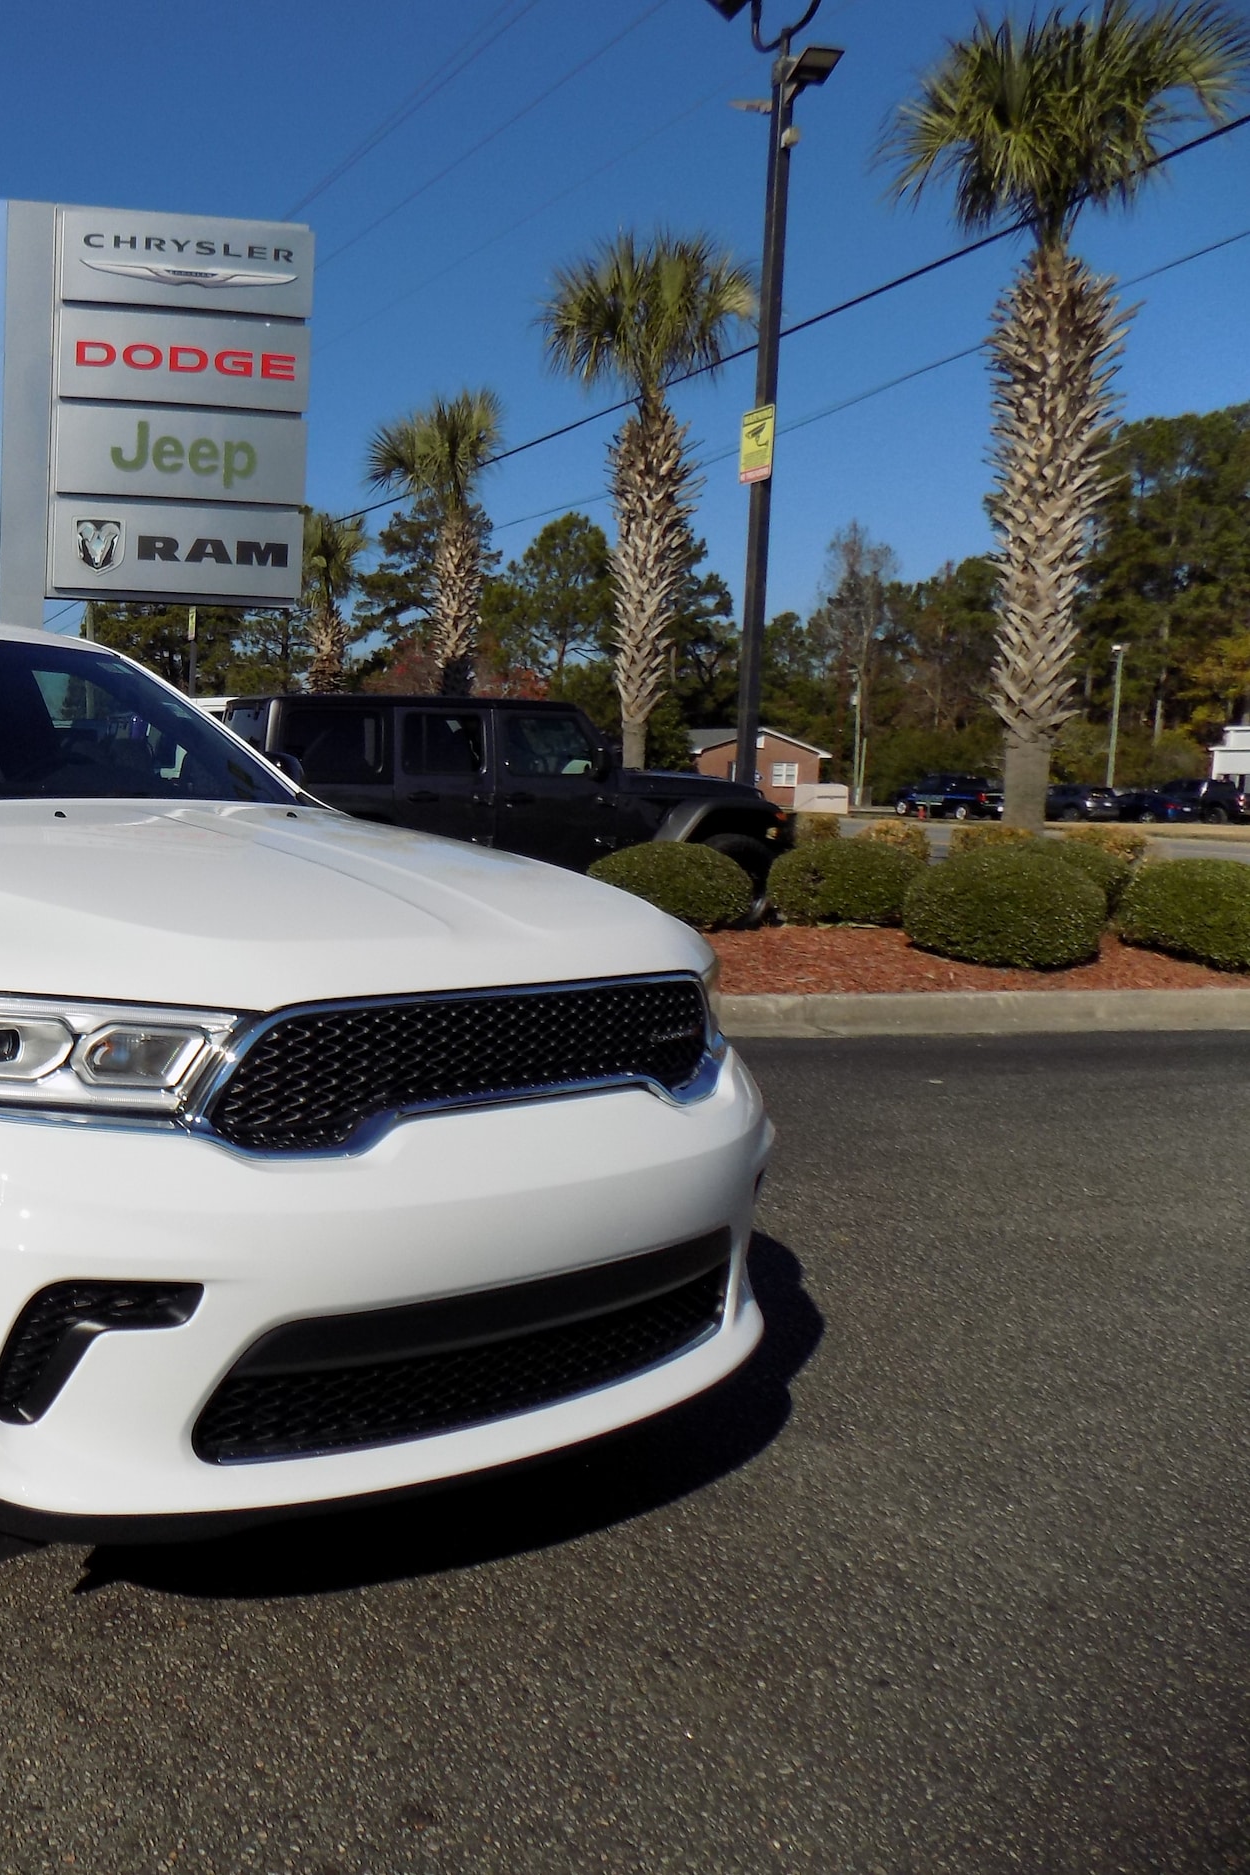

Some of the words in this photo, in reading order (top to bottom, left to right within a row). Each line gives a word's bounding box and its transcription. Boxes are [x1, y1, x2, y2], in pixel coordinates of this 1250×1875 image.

[83, 233, 294, 264] CHRYSLER
[75, 340, 296, 381] DODGE
[110, 420, 257, 489] Jeep
[137, 535, 289, 569] RAM
